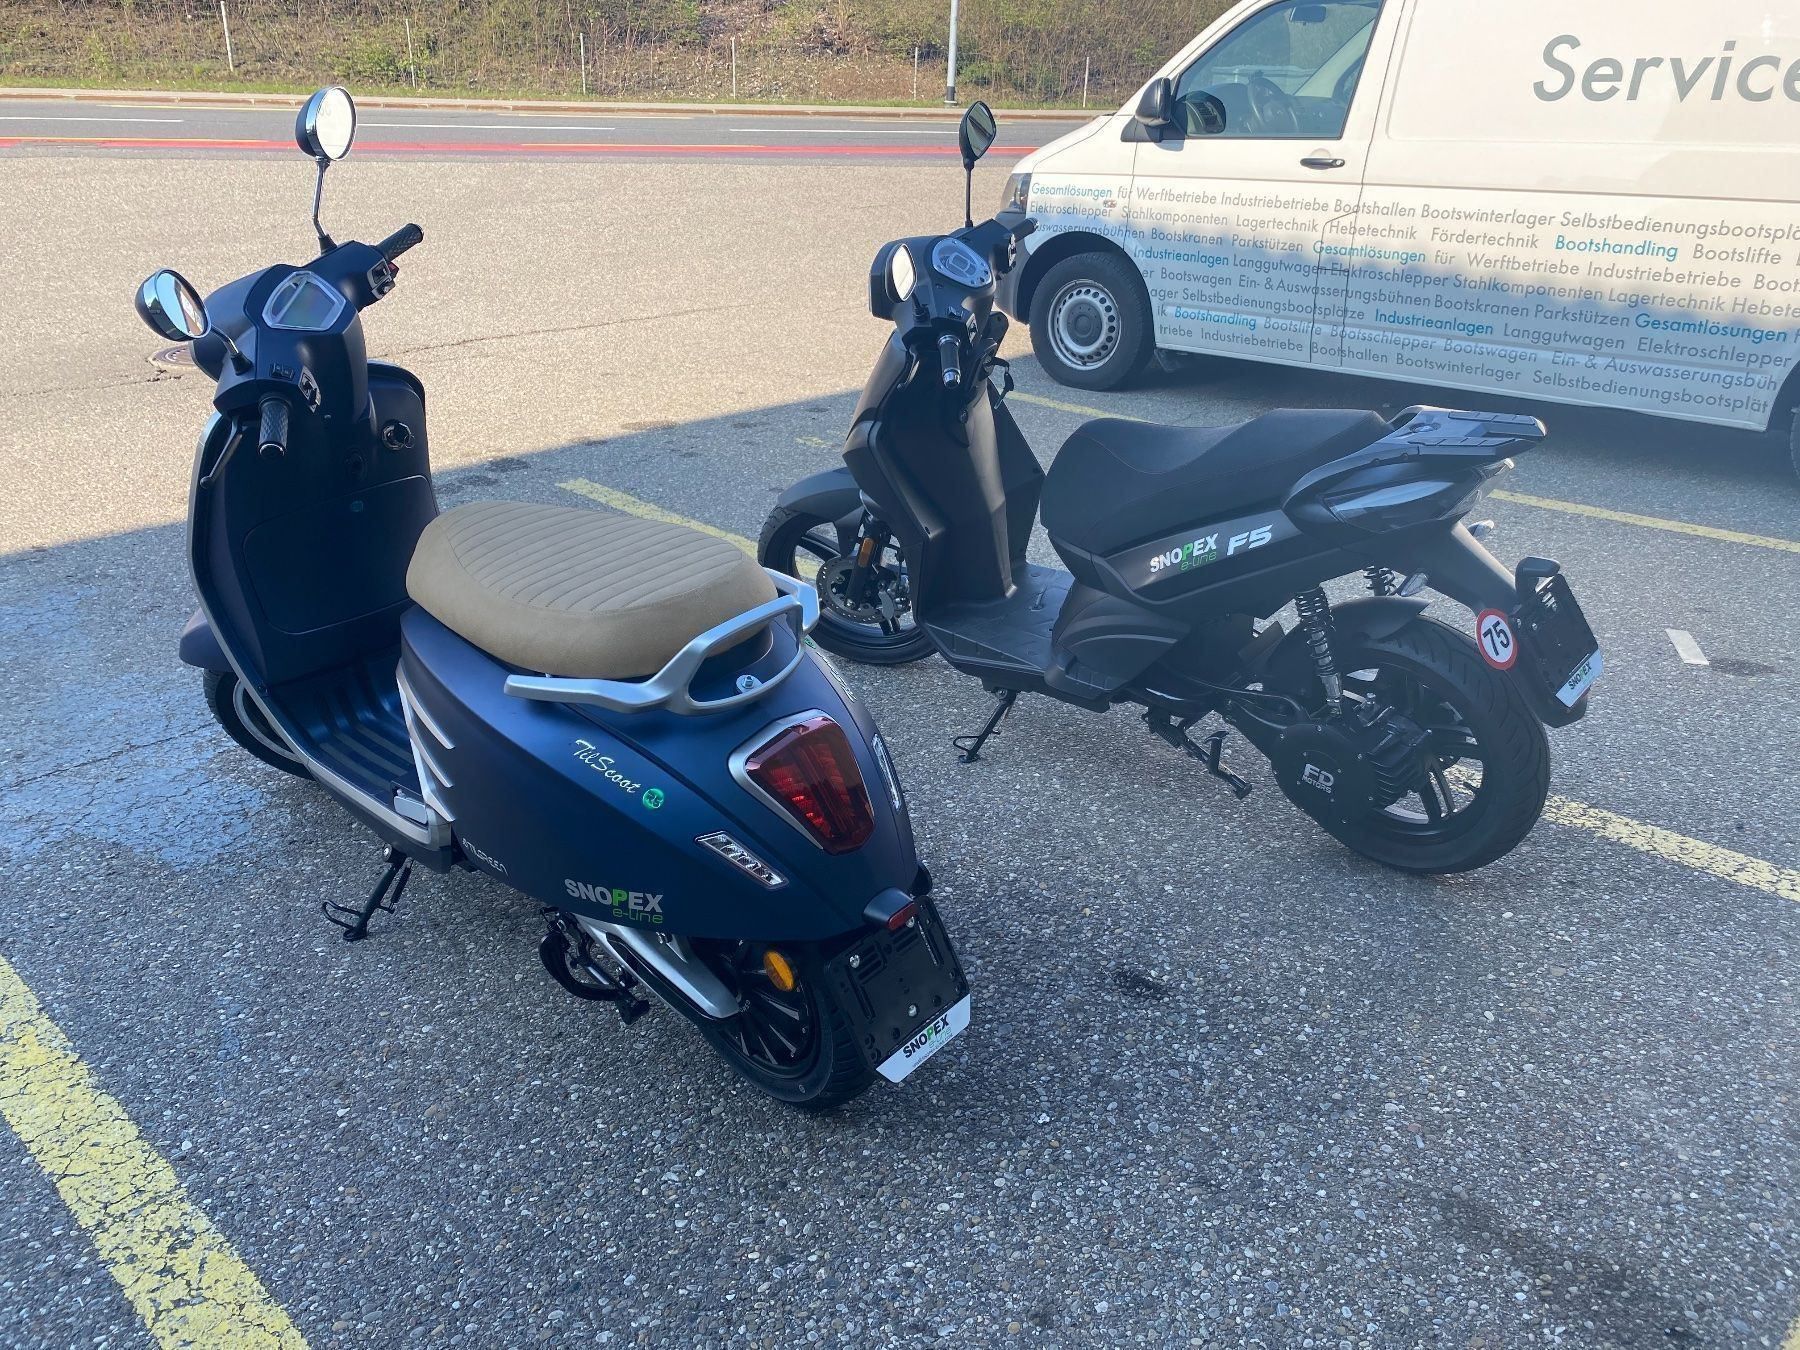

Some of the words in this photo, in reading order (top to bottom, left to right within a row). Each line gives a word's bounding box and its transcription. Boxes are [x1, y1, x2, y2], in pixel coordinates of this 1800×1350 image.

[1031, 183, 1112, 200] Gesamtlösungen
[1117, 185, 1132, 199] für
[1136, 187, 1217, 205] Werftbetriebe
[1221, 192, 1329, 212] Industriebetriebe
[1334, 199, 1416, 218] Bootshallen
[1421, 204, 1556, 229] Bootswinterlager
[1030, 200, 1112, 220] Elektroschlepper
[1121, 206, 1228, 226] Stahlkomponenten
[1236, 215, 1318, 232] Lagertechnik
[1329, 222, 1417, 240] Hebetechnik
[1431, 227, 1540, 249] Fördertechnik
[1555, 235, 1678, 262] Bootshandling
[1693, 243, 1781, 265] Bootslifte
[1036, 223, 1145, 239] uswasserungsbühnen
[1151, 227, 1223, 246] Bootskranen
[1231, 233, 1303, 252] Parkstützen
[1313, 240, 1426, 265] Gesamtlösungen
[1434, 250, 1455, 265] für
[1467, 252, 1579, 275] Werftbetriebe
[1587, 261, 1741, 288] Industriebetriebe
[1754, 273, 1800, 293] Boot
[1133, 247, 1229, 268] Industrieanlagen
[1233, 254, 1326, 277] Langgutwagen
[1331, 262, 1449, 288] Elektroschlepper
[1452, 273, 1603, 300] Stahlkomponenten
[1608, 287, 1726, 312] Lagertechnik
[1161, 267, 1232, 288] Bootswagen
[1239, 275, 1260, 289] Ein-
[1264, 277, 1273, 291] &
[1276, 279, 1431, 308] Auswasserungsbühnen
[1434, 294, 1529, 318] Bootskranen
[1534, 304, 1630, 328] Parkstützen
[1635, 312, 1788, 344] Gesamtlösungen
[1182, 288, 1365, 321] Selbstbedienungsbootsplätze
[1375, 308, 1494, 337] Industrieanlagen
[1504, 323, 1625, 350] Langgutwagen
[1637, 336, 1792, 368] Elektroschlepper
[1174, 306, 1257, 331] Bootshandling
[1263, 319, 1321, 335] Bootslifte
[1330, 324, 1437, 350] Bootsschlepper
[1443, 338, 1537, 363] Bootswagen
[1552, 350, 1580, 366] Ein-
[1584, 354, 1597, 370] &
[1201, 327, 1303, 352] Industriebetriebe
[1312, 341, 1388, 363] Bootshallen
[1396, 352, 1521, 381] Bootswinterlager
[1150, 532, 1219, 573] SNOPEX
[1226, 524, 1274, 556] F5
[1481, 620, 1510, 656] 75
[1567, 661, 1593, 690] SNOPEX
[1301, 775, 1332, 794] MOTORS
[564, 878, 664, 913] SNOPEX
[902, 1013, 950, 1059] SNOPEX
